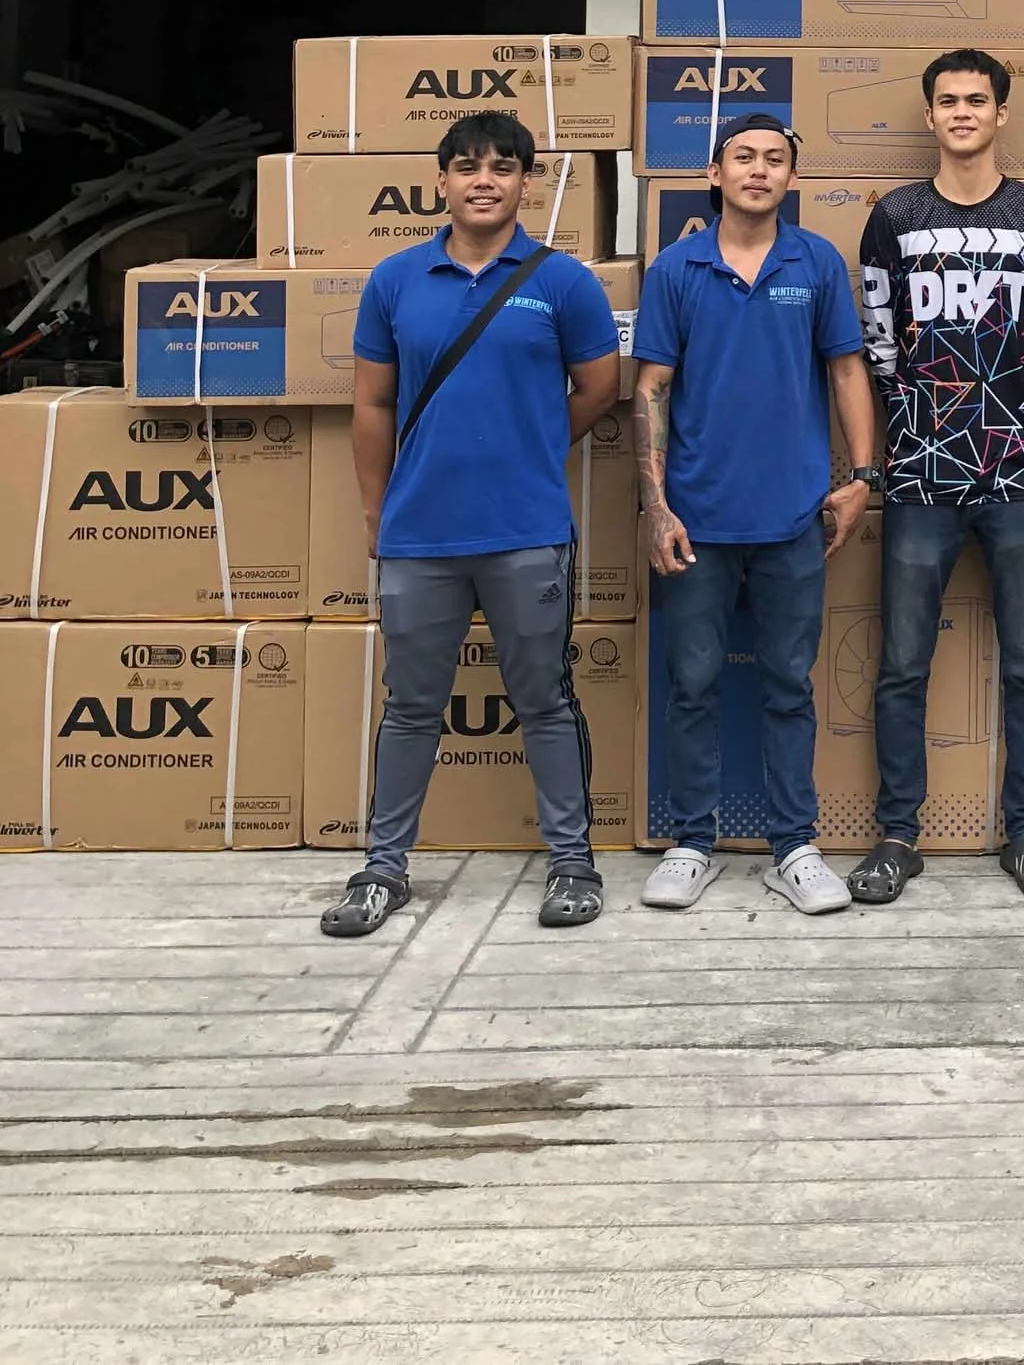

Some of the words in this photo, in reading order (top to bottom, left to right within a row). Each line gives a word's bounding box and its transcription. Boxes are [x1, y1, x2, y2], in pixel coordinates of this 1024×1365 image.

[405, 69, 518, 99] AUX
[673, 67, 767, 92] AUX
[405, 110, 426, 121] AIR
[368, 186, 450, 216] AU
[814, 191, 862, 204] INVERTER
[368, 227, 390, 237] AIR
[165, 290, 260, 318] AUX
[165, 341, 184, 351] AIR
[131, 420, 156, 441] 10
[69, 470, 221, 512] AUX
[69, 526, 97, 540] AIR
[239, 590, 300, 600] TECHNOLOGY
[124, 646, 150, 667] 10
[196, 646, 210, 667] 5
[57, 697, 214, 739] AUX
[57, 754, 86, 768] AIR
[92, 753, 214, 768] CONDITIONER
